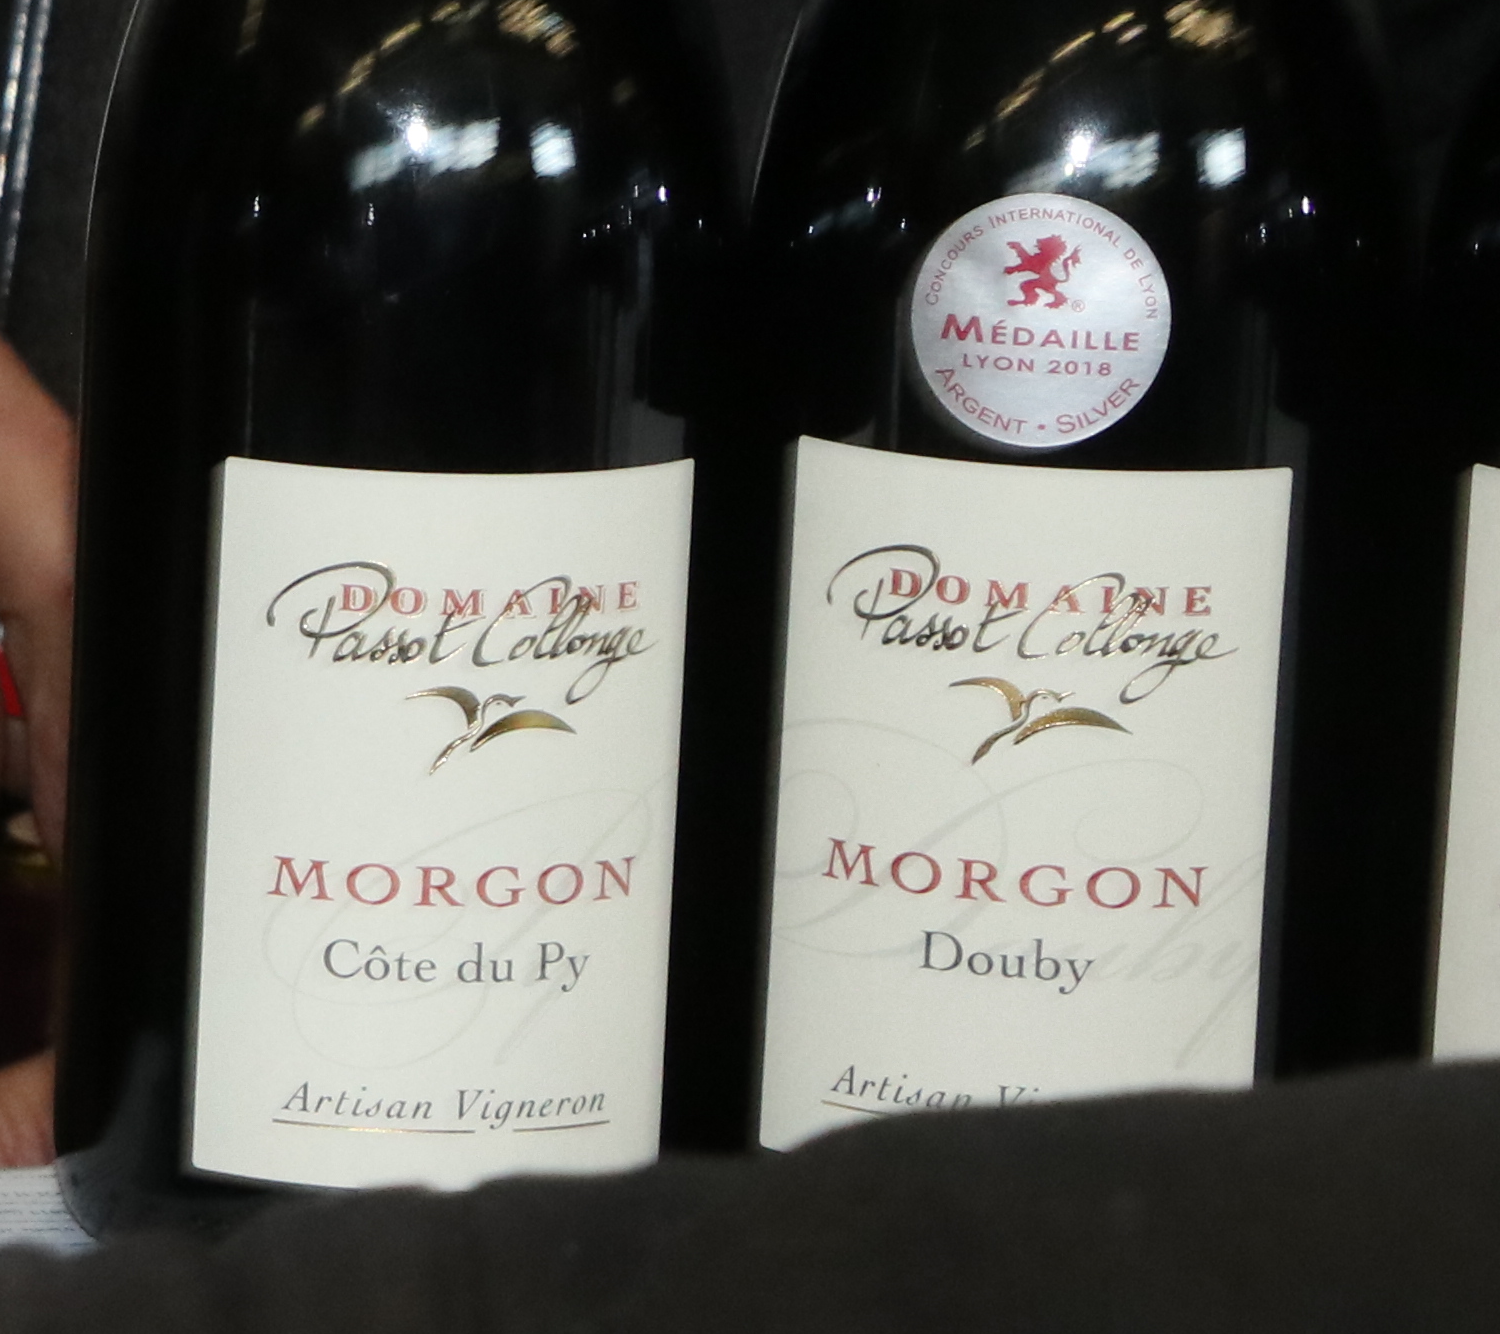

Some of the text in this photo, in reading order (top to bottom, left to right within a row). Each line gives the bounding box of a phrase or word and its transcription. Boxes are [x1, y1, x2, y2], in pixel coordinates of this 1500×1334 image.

[925, 207, 1158, 320] CONCOURS INTERNATIONAL DE LYON
[941, 313, 1140, 352] MÉDAILLE
[962, 353, 1112, 376] LYON 2018
[935, 367, 1141, 435] ARGENT SILVER
[340, 581, 642, 619] DOMAINE
[888, 568, 1213, 617] DOMAINE
[267, 561, 659, 705] Passot Collonge
[827, 544, 1239, 705] Passot Collonge
[266, 855, 638, 909] MORGON
[821, 837, 1209, 910] MORGON
[322, 938, 591, 992] Côte du Py
[919, 929, 1096, 994] Douby
[281, 1081, 608, 1131] Artisan Vigneron
[830, 1064, 972, 1108] Artisan
